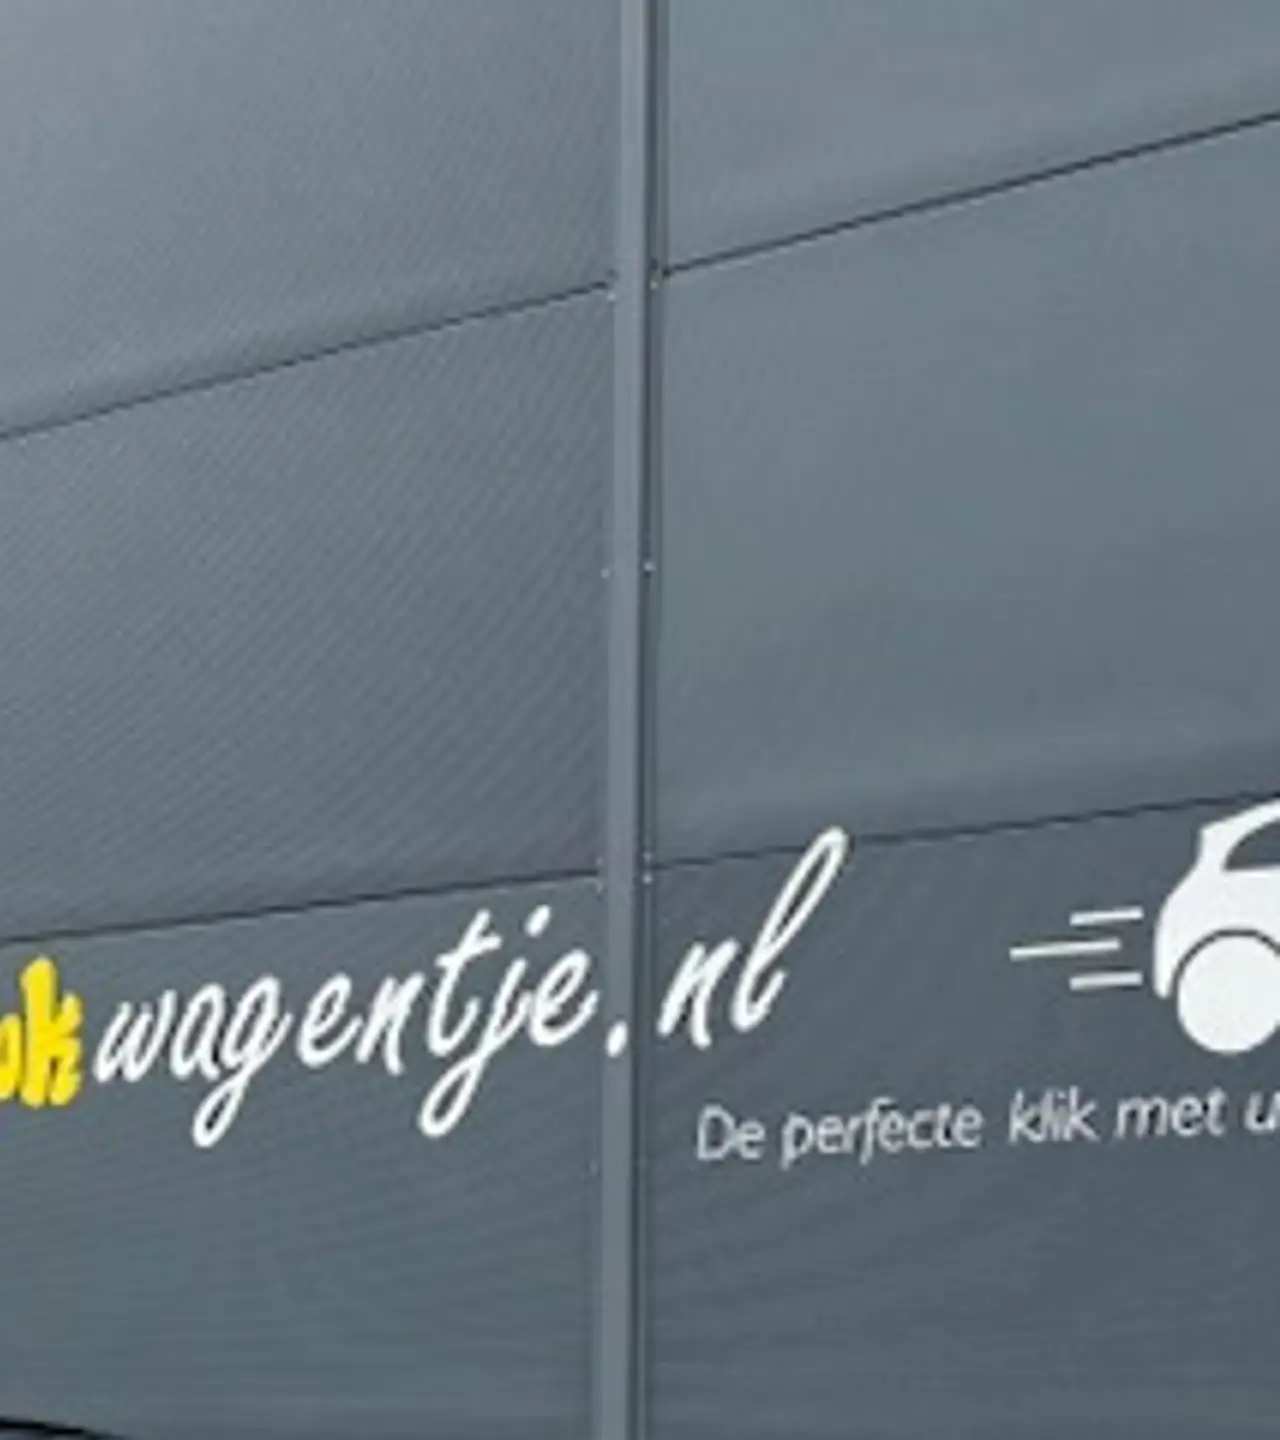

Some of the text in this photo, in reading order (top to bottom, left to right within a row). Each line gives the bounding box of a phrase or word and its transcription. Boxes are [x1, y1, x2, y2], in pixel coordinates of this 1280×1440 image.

[696, 1103, 767, 1160] De
[779, 1096, 984, 1170] perfecte
[1007, 1084, 1102, 1143] klik
[1114, 1086, 1227, 1138] met
